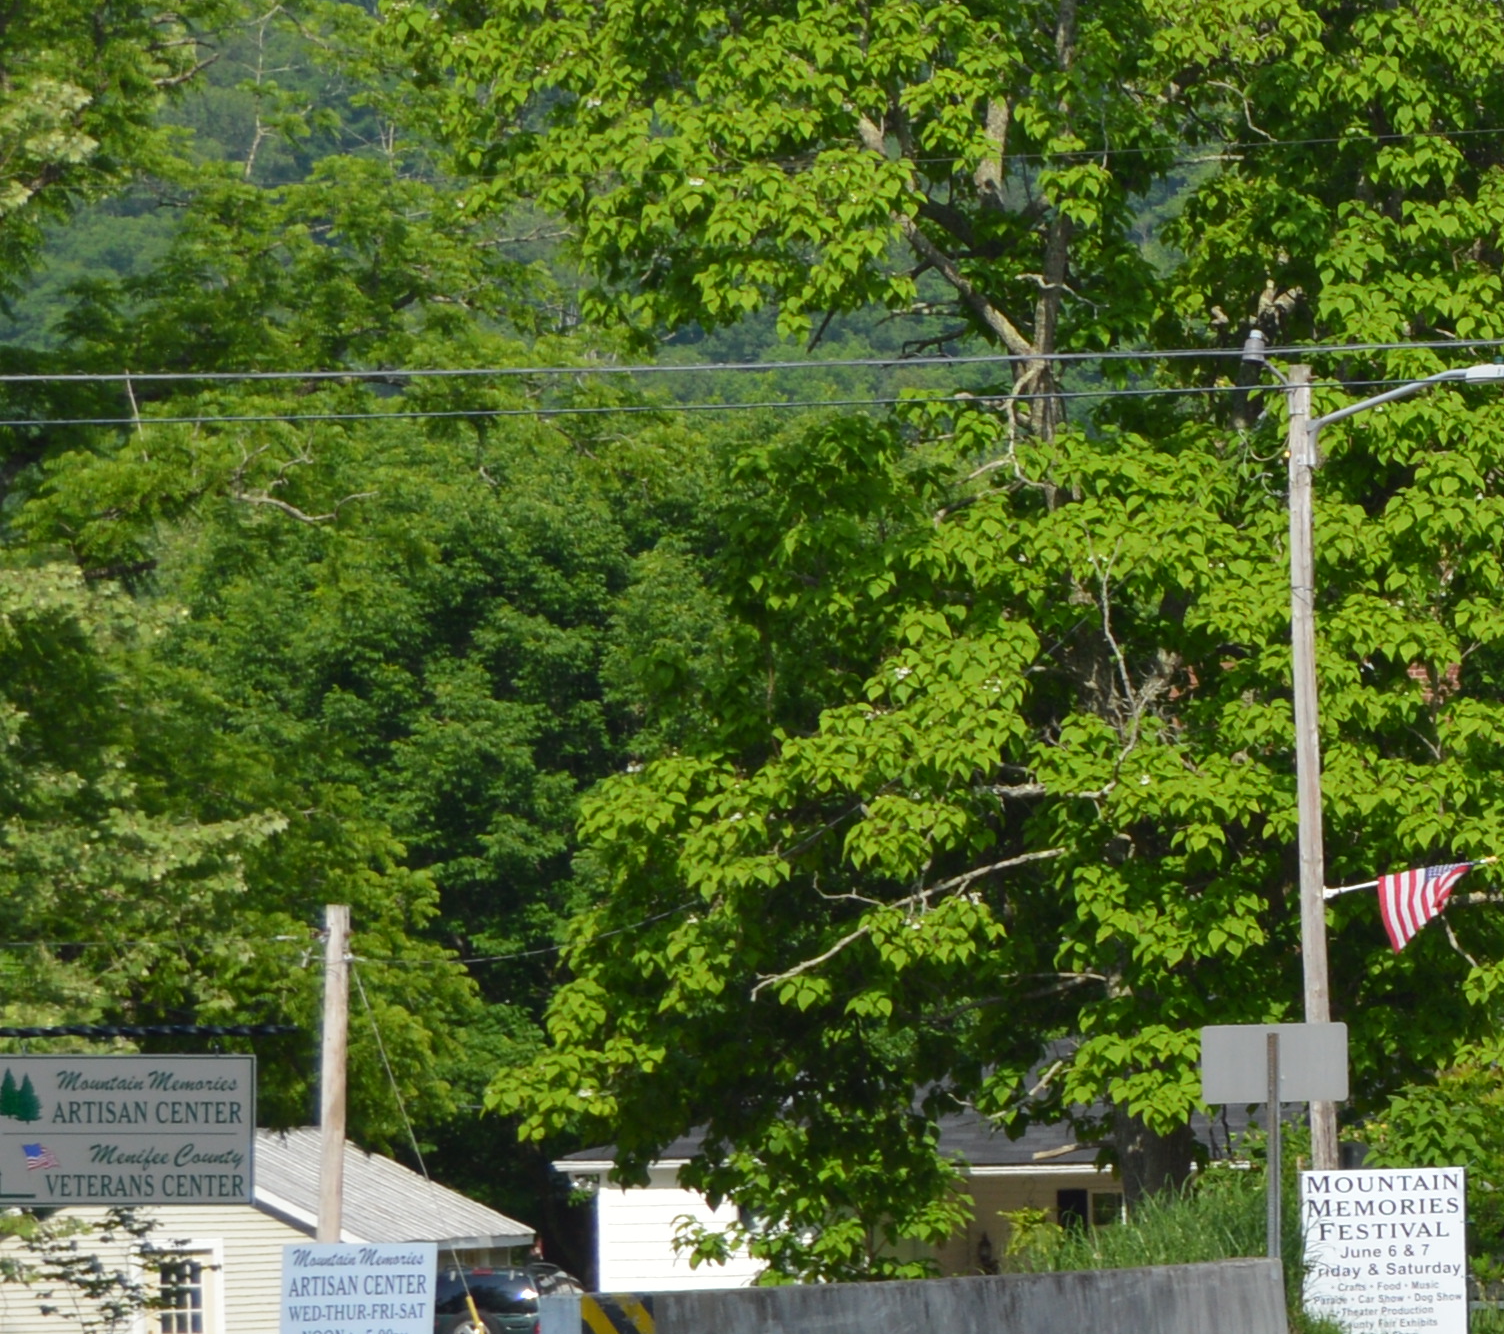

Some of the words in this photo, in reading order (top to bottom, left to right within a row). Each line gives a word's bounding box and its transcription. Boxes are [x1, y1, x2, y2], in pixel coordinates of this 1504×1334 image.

[57, 1070, 143, 1091] Mountain
[148, 1070, 238, 1090] Memories
[52, 1101, 147, 1124] ARTISAN
[155, 1101, 241, 1123] CENTER
[90, 1144, 169, 1170] Menifee
[174, 1143, 244, 1169] County
[45, 1174, 154, 1197] VETERANS
[162, 1174, 244, 1196] CENTER
[1307, 1173, 1459, 1194] MOUNTAIN
[1307, 1197, 1459, 1217] MEMORIES
[1319, 1221, 1450, 1241] FESTIVAL
[293, 1249, 356, 1267] Mountain
[359, 1248, 424, 1266] Memories
[1340, 1246, 1381, 1259] June
[1388, 1245, 1397, 1257] 6
[1403, 1244, 1414, 1257] &
[1421, 1243, 1430, 1256] 7
[1317, 1264, 1361, 1279] riday
[1368, 1263, 1379, 1275] &
[1386, 1262, 1461, 1275] Saturday
[289, 1275, 358, 1297] ARTISAN
[364, 1274, 427, 1295] CENTER
[1338, 1282, 1366, 1292] Crafts
[1377, 1281, 1401, 1291] Food
[1411, 1280, 1439, 1290] Music
[1358, 1294, 1374, 1304] Car
[1378, 1294, 1404, 1303] Show
[1414, 1294, 1433, 1304] Dog
[1436, 1292, 1462, 1301] Show
[1342, 1306, 1378, 1317] Theater
[1381, 1306, 1434, 1316] Production
[1378, 1319, 1396, 1328] Fair
[1400, 1317, 1438, 1328] Exhibits
